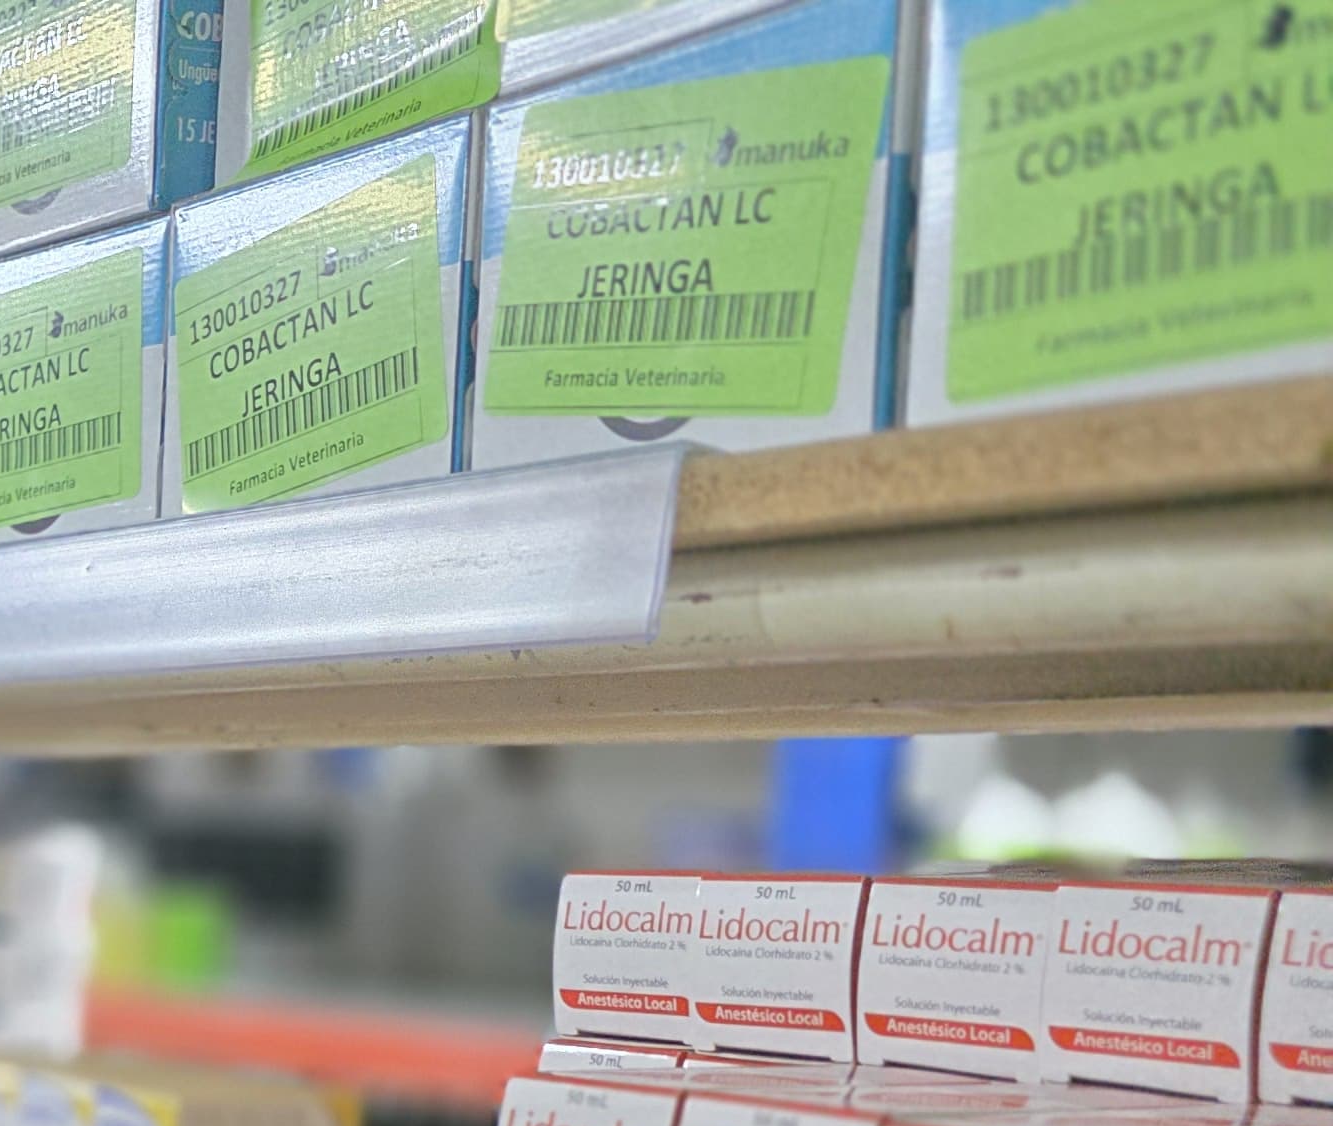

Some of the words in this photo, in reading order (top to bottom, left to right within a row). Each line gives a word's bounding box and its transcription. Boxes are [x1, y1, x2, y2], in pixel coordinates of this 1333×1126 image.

[987, 31, 1216, 133] 130010327
[178, 116, 196, 142] 15
[345, 99, 422, 141] Veterinaria
[1016, 78, 1282, 185] COBACTAN
[735, 131, 850, 166] manuka
[14, 151, 71, 179] Veterinaria
[532, 142, 685, 189] 130010327
[547, 193, 724, 239] COBACTAN
[735, 188, 776, 225] LC
[1074, 161, 1281, 250] JERINGA
[577, 258, 714, 299] JERINGA
[63, 303, 128, 337] manuka
[190, 270, 301, 345] 130010327
[209, 296, 337, 379] COBACTAN
[347, 280, 374, 317] LC
[68, 348, 90, 377] LC
[545, 368, 618, 388] Farmacia
[625, 366, 726, 388] Veterinaria
[242, 352, 342, 417] JERINGA
[229, 460, 285, 496] Farmacia
[289, 431, 364, 472] Veterinaria
[15, 475, 76, 501] Veterinaria
[615, 881, 631, 893] 50
[634, 881, 653, 893] mL
[755, 887, 771, 898] 50
[773, 887, 796, 899] mL
[937, 892, 956, 906] 50
[960, 893, 983, 908] mL
[564, 900, 693, 935] Lidocalm
[1131, 895, 1154, 911] 50
[1157, 897, 1184, 913] mL
[699, 908, 840, 944] Lidocalm
[872, 913, 1034, 957] Lidocalm
[615, 937, 667, 950] Clorhidrato
[669, 940, 675, 950] 2
[677, 942, 686, 952] %
[755, 947, 812, 961] Clorhidrato
[814, 950, 821, 960] 2
[823, 951, 833, 961] %
[1058, 919, 1240, 966] Lidocalm
[583, 974, 620, 987] Solución
[623, 976, 669, 989] Inyectable
[721, 985, 762, 999] Solución
[764, 988, 813, 1002] Inyectable
[577, 992, 642, 1009] Anestésico
[645, 996, 677, 1011] Local
[715, 1005, 785, 1023] Anestésico
[788, 1010, 823, 1026] Local
[894, 996, 940, 1014] Solución
[943, 1001, 1000, 1017] Inyectable
[887, 1018, 966, 1040] Anestésico
[970, 1025, 1011, 1045] Local
[1073, 1031, 1166, 1056] Anestésico
[1170, 1040, 1213, 1061] Local
[589, 1053, 604, 1066] 50
[606, 1054, 623, 1068] mL
